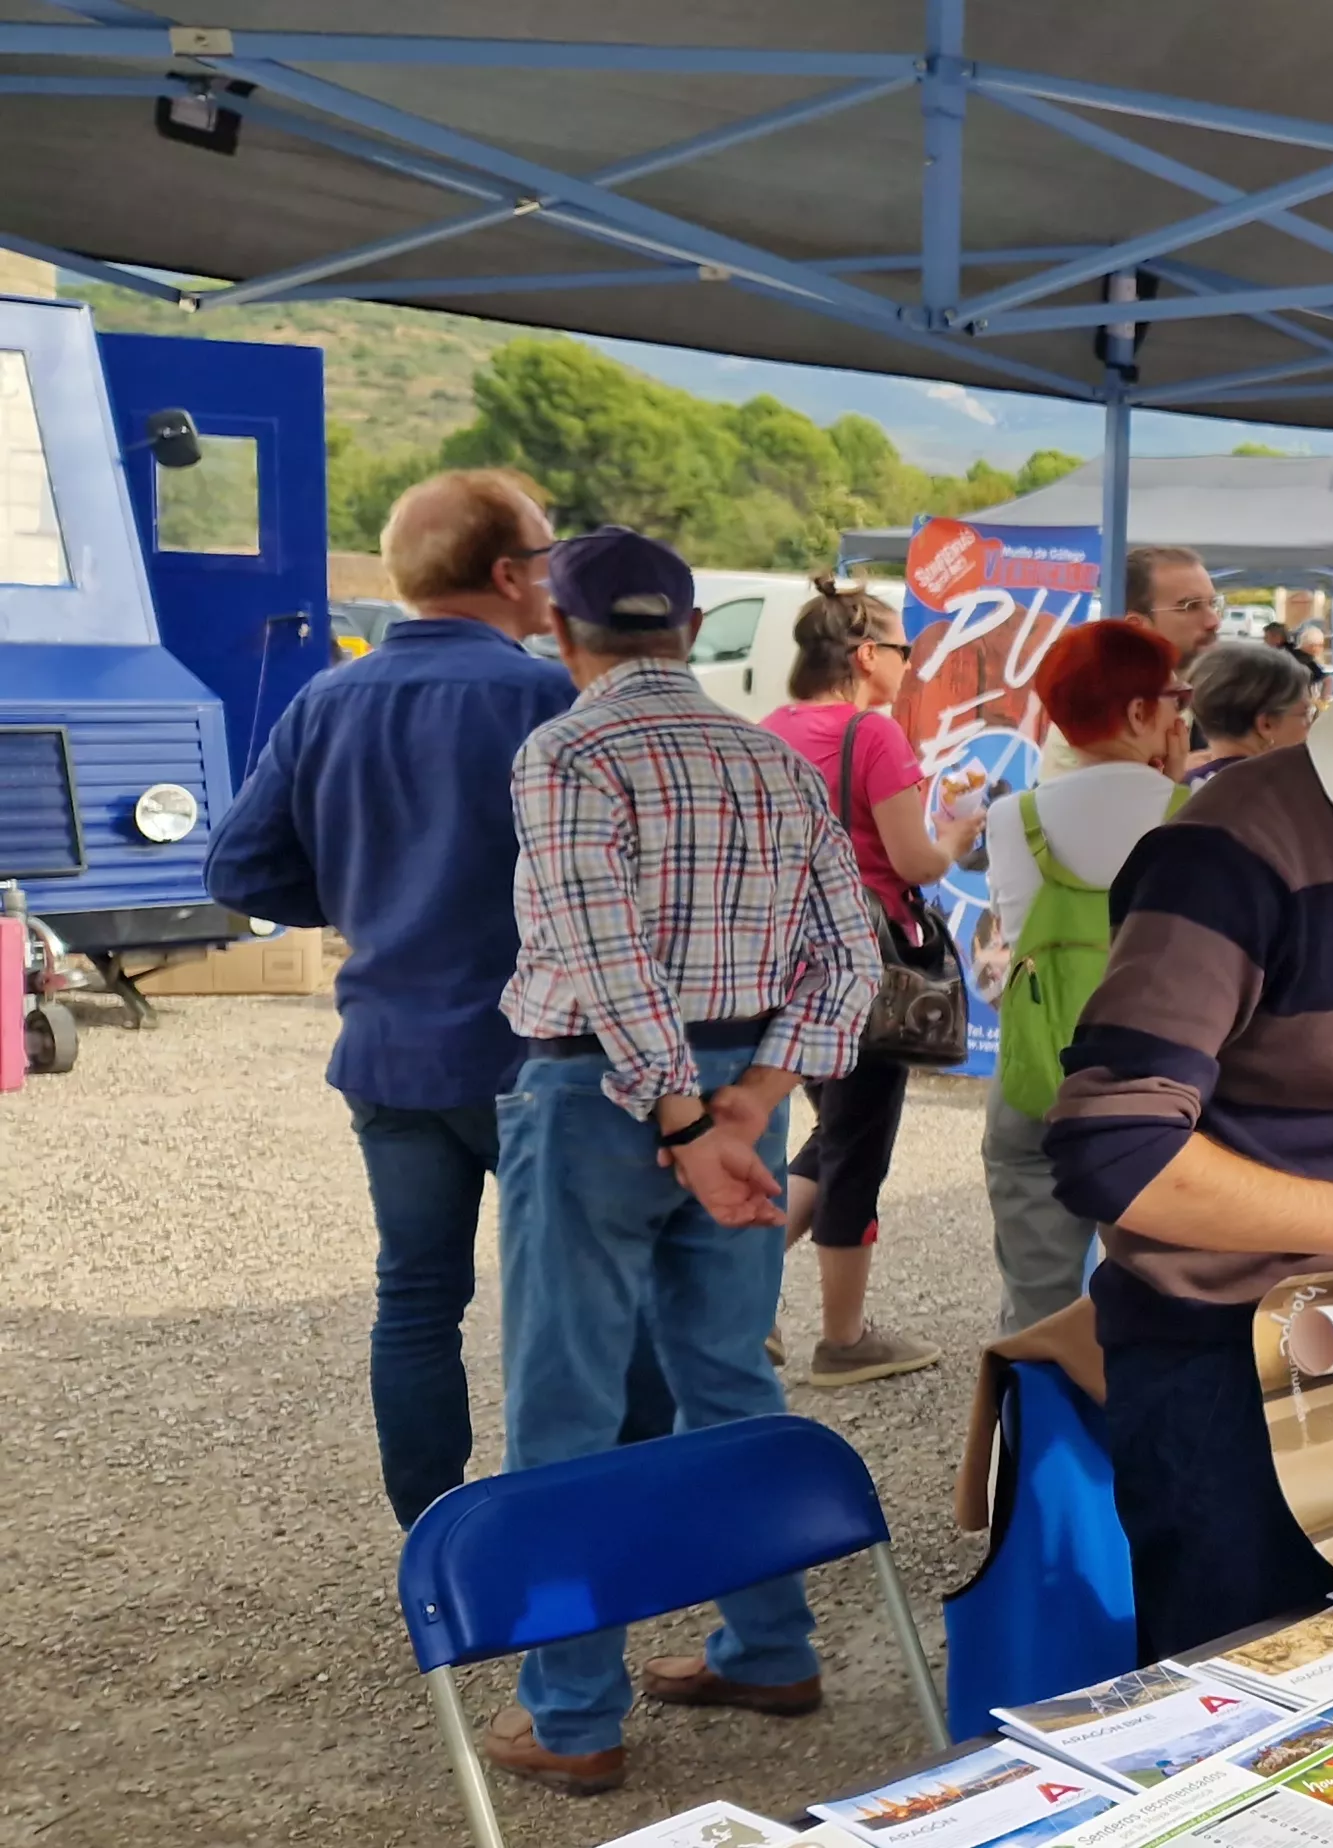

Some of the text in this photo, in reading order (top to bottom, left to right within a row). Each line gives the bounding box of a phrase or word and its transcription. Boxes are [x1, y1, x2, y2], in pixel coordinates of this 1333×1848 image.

[888, 1816, 958, 1844] ARAGÓN
[1077, 1811, 1142, 1847] Senderos
[1141, 1769, 1228, 1816] recomendados
